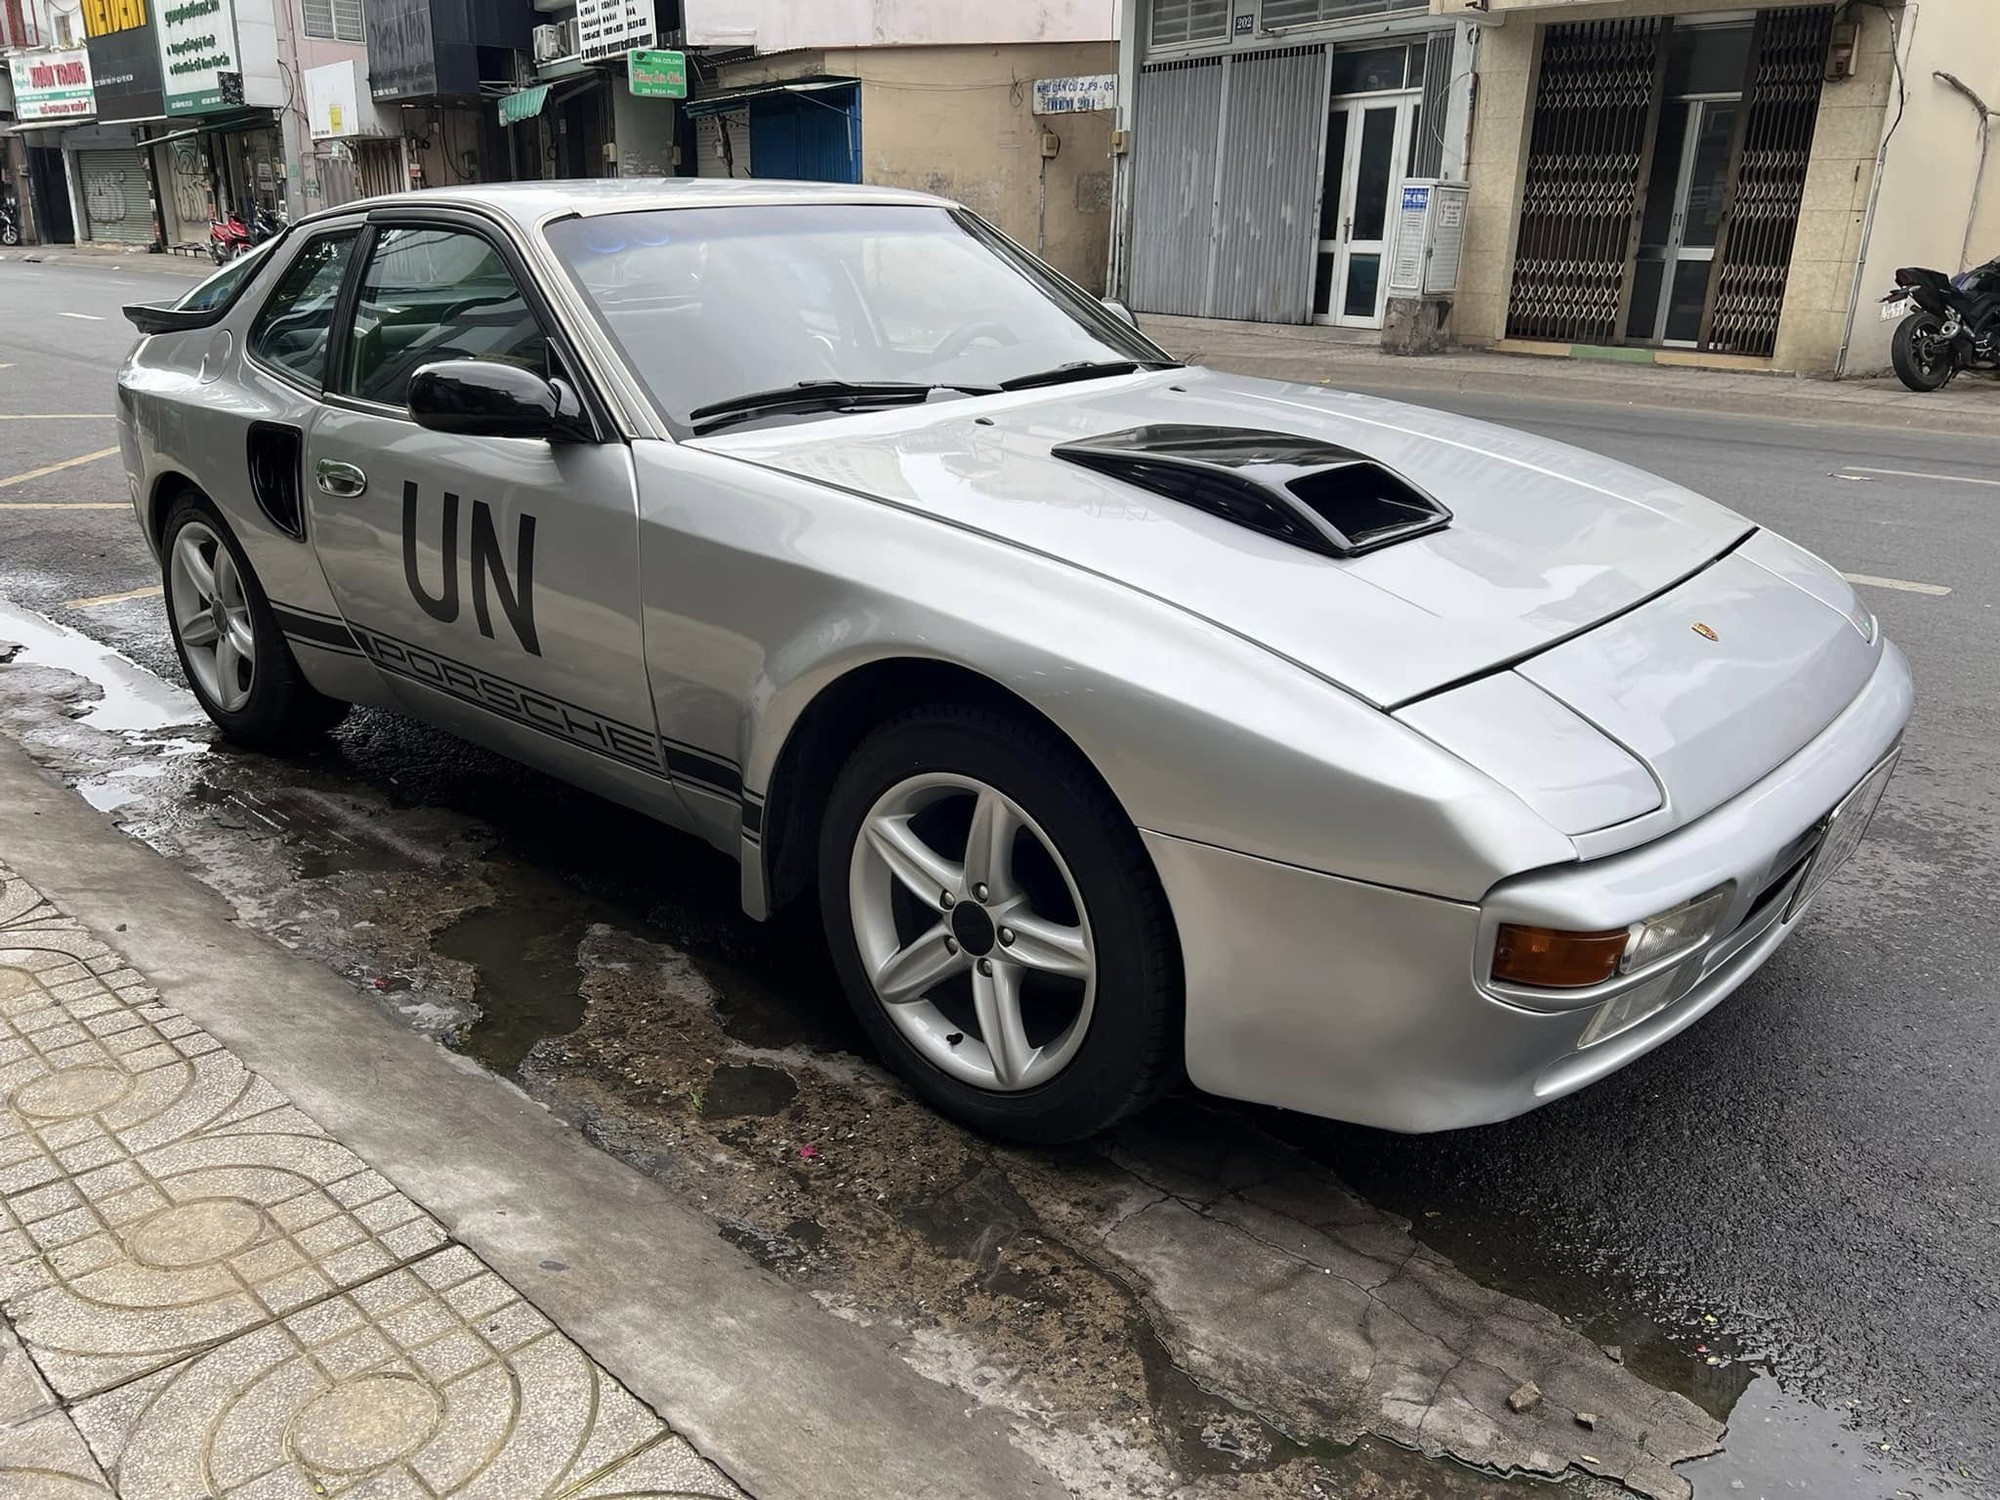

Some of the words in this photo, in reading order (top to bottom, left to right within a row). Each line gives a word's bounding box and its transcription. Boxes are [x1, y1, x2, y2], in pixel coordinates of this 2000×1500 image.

[1236, 16, 1252, 29] 202
[53, 61, 87, 86] TRANG
[403, 481, 542, 657] UN
[371, 636, 661, 768] PORSCHE
